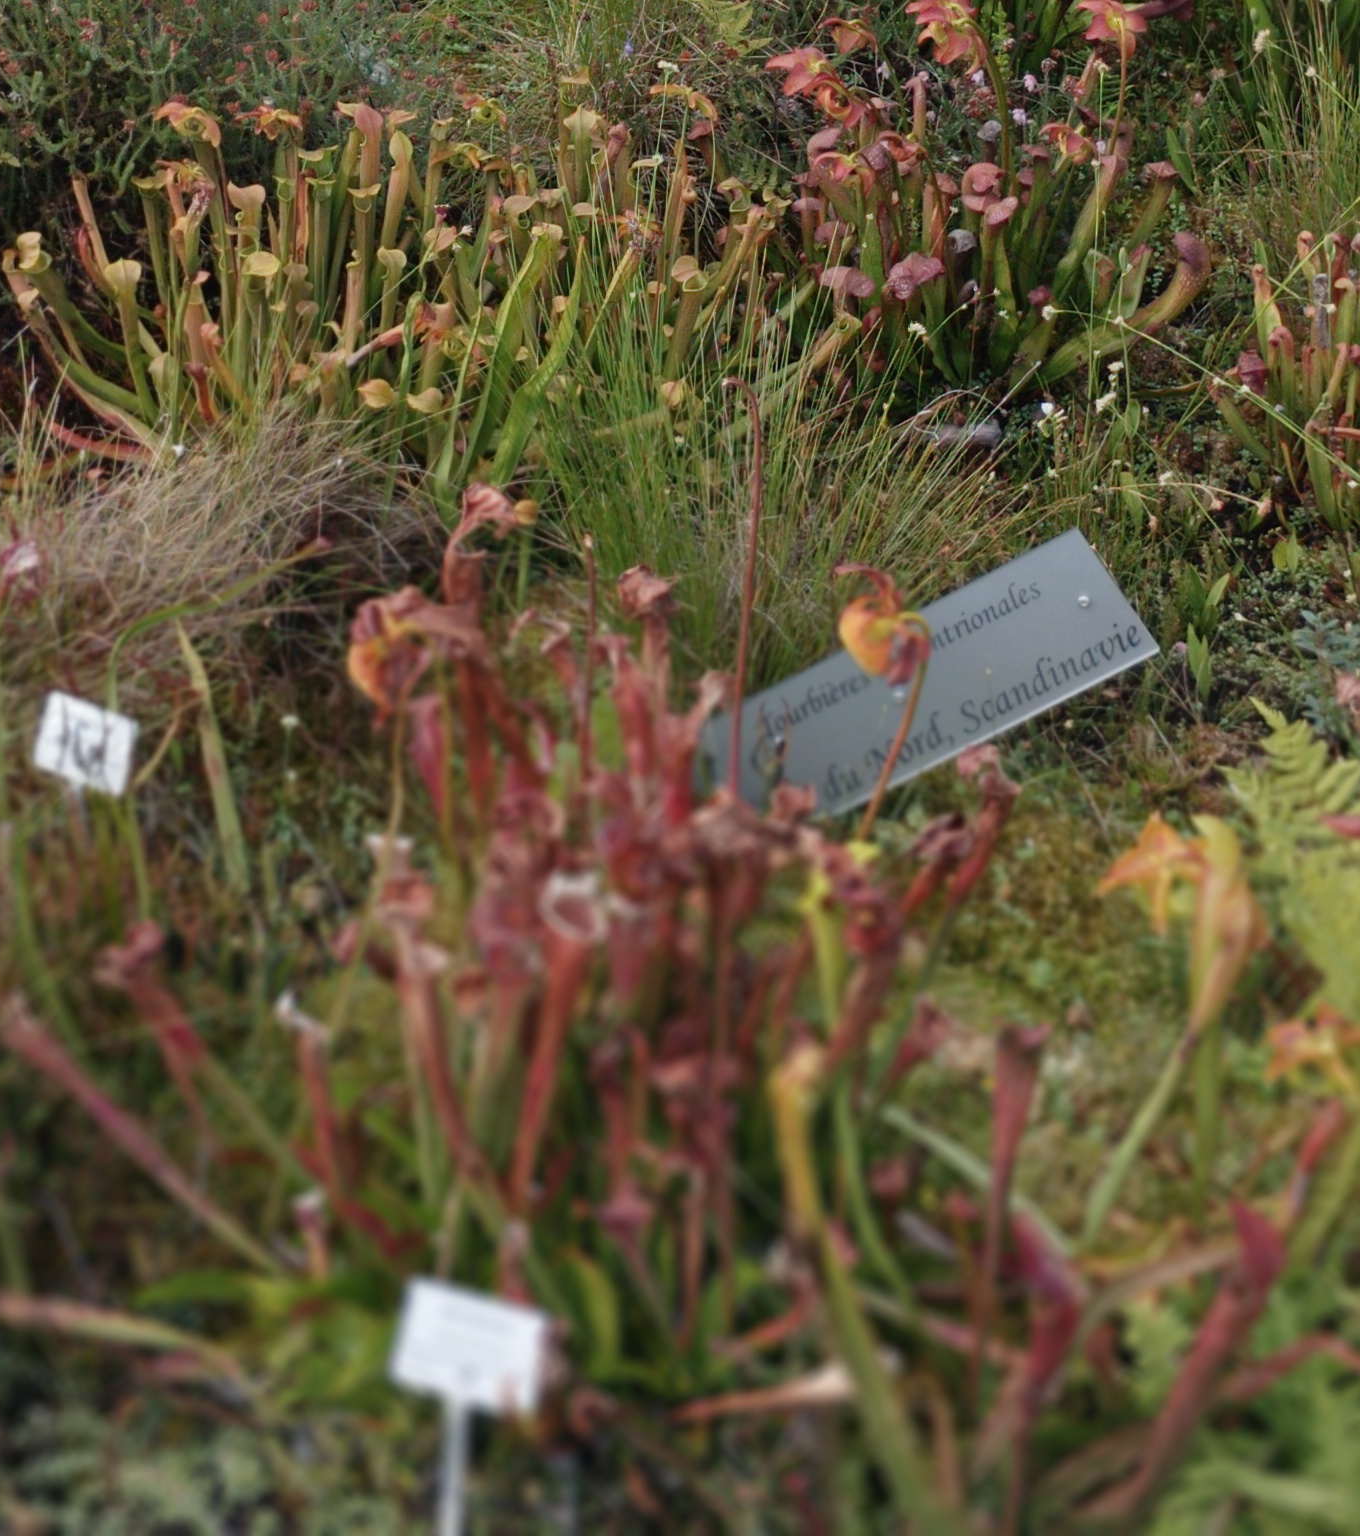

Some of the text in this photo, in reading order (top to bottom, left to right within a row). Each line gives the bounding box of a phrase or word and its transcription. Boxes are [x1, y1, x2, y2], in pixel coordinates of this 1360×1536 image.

[762, 671, 872, 739] Tourbières
[821, 621, 1142, 804] du Nord, Scandinavie
